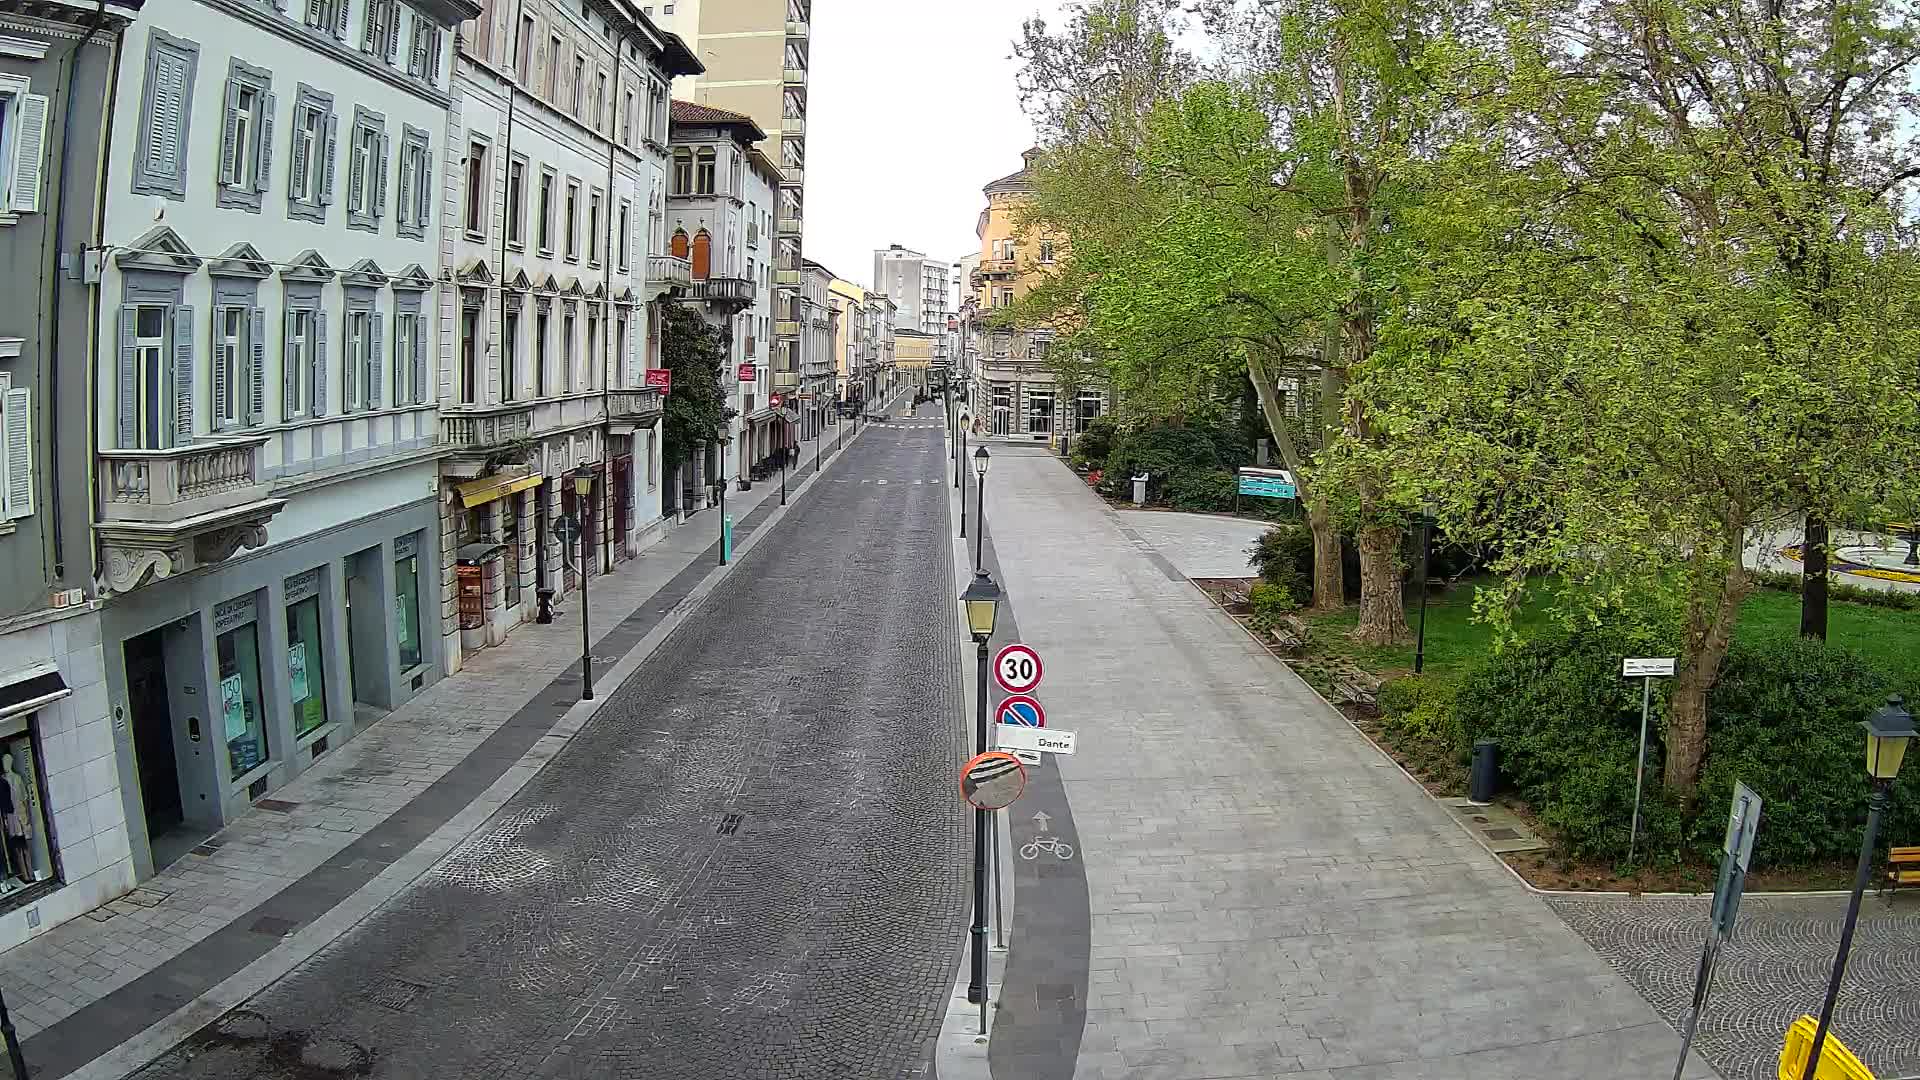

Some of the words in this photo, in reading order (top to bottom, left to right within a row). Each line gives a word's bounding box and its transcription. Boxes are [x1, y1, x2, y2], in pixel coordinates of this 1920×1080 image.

[1005, 658, 1032, 680] 30
[223, 677, 240, 700] 130
[1038, 738, 1070, 750] Dante
